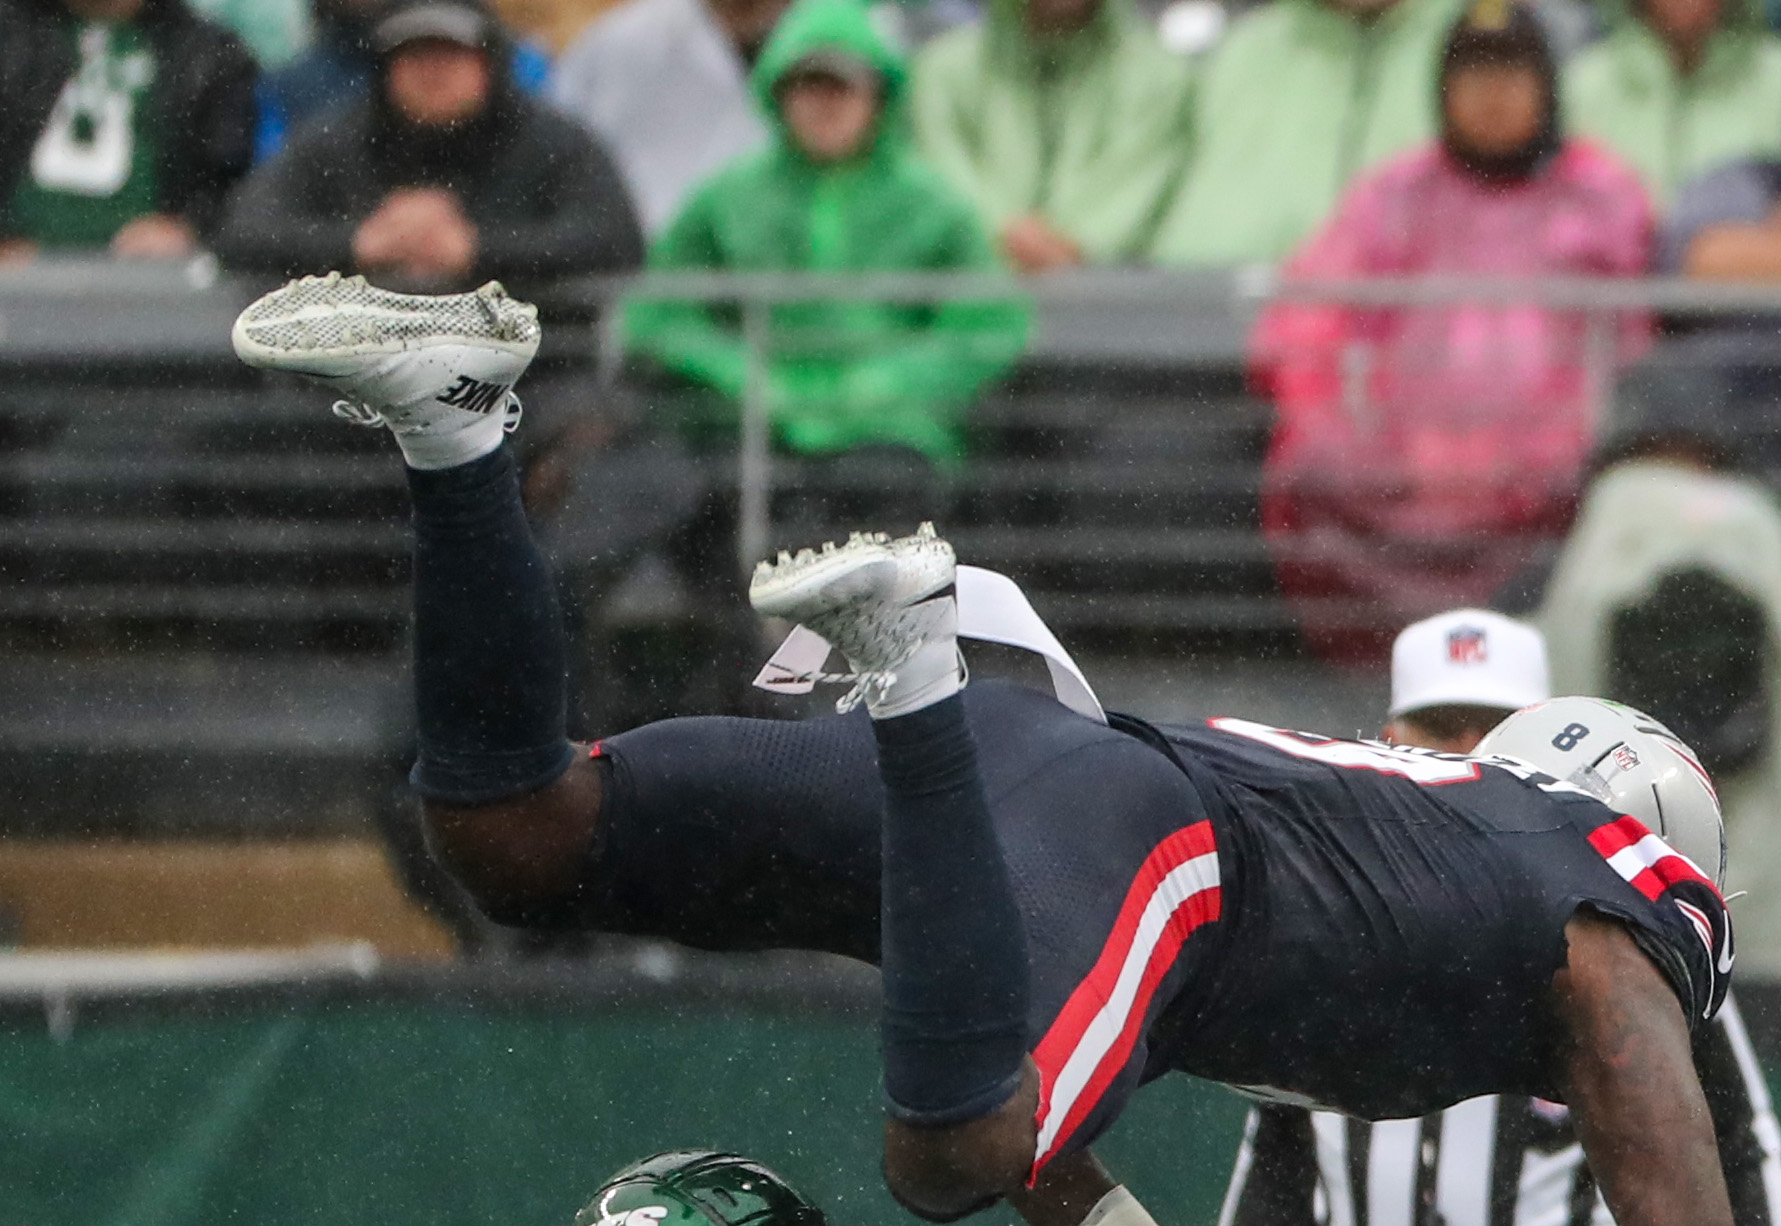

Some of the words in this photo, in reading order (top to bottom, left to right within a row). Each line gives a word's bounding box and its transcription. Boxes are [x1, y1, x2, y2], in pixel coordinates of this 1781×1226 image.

[435, 374, 510, 414] NIKE
[1551, 722, 1591, 752] 8
[1614, 749, 1634, 770] NFL
